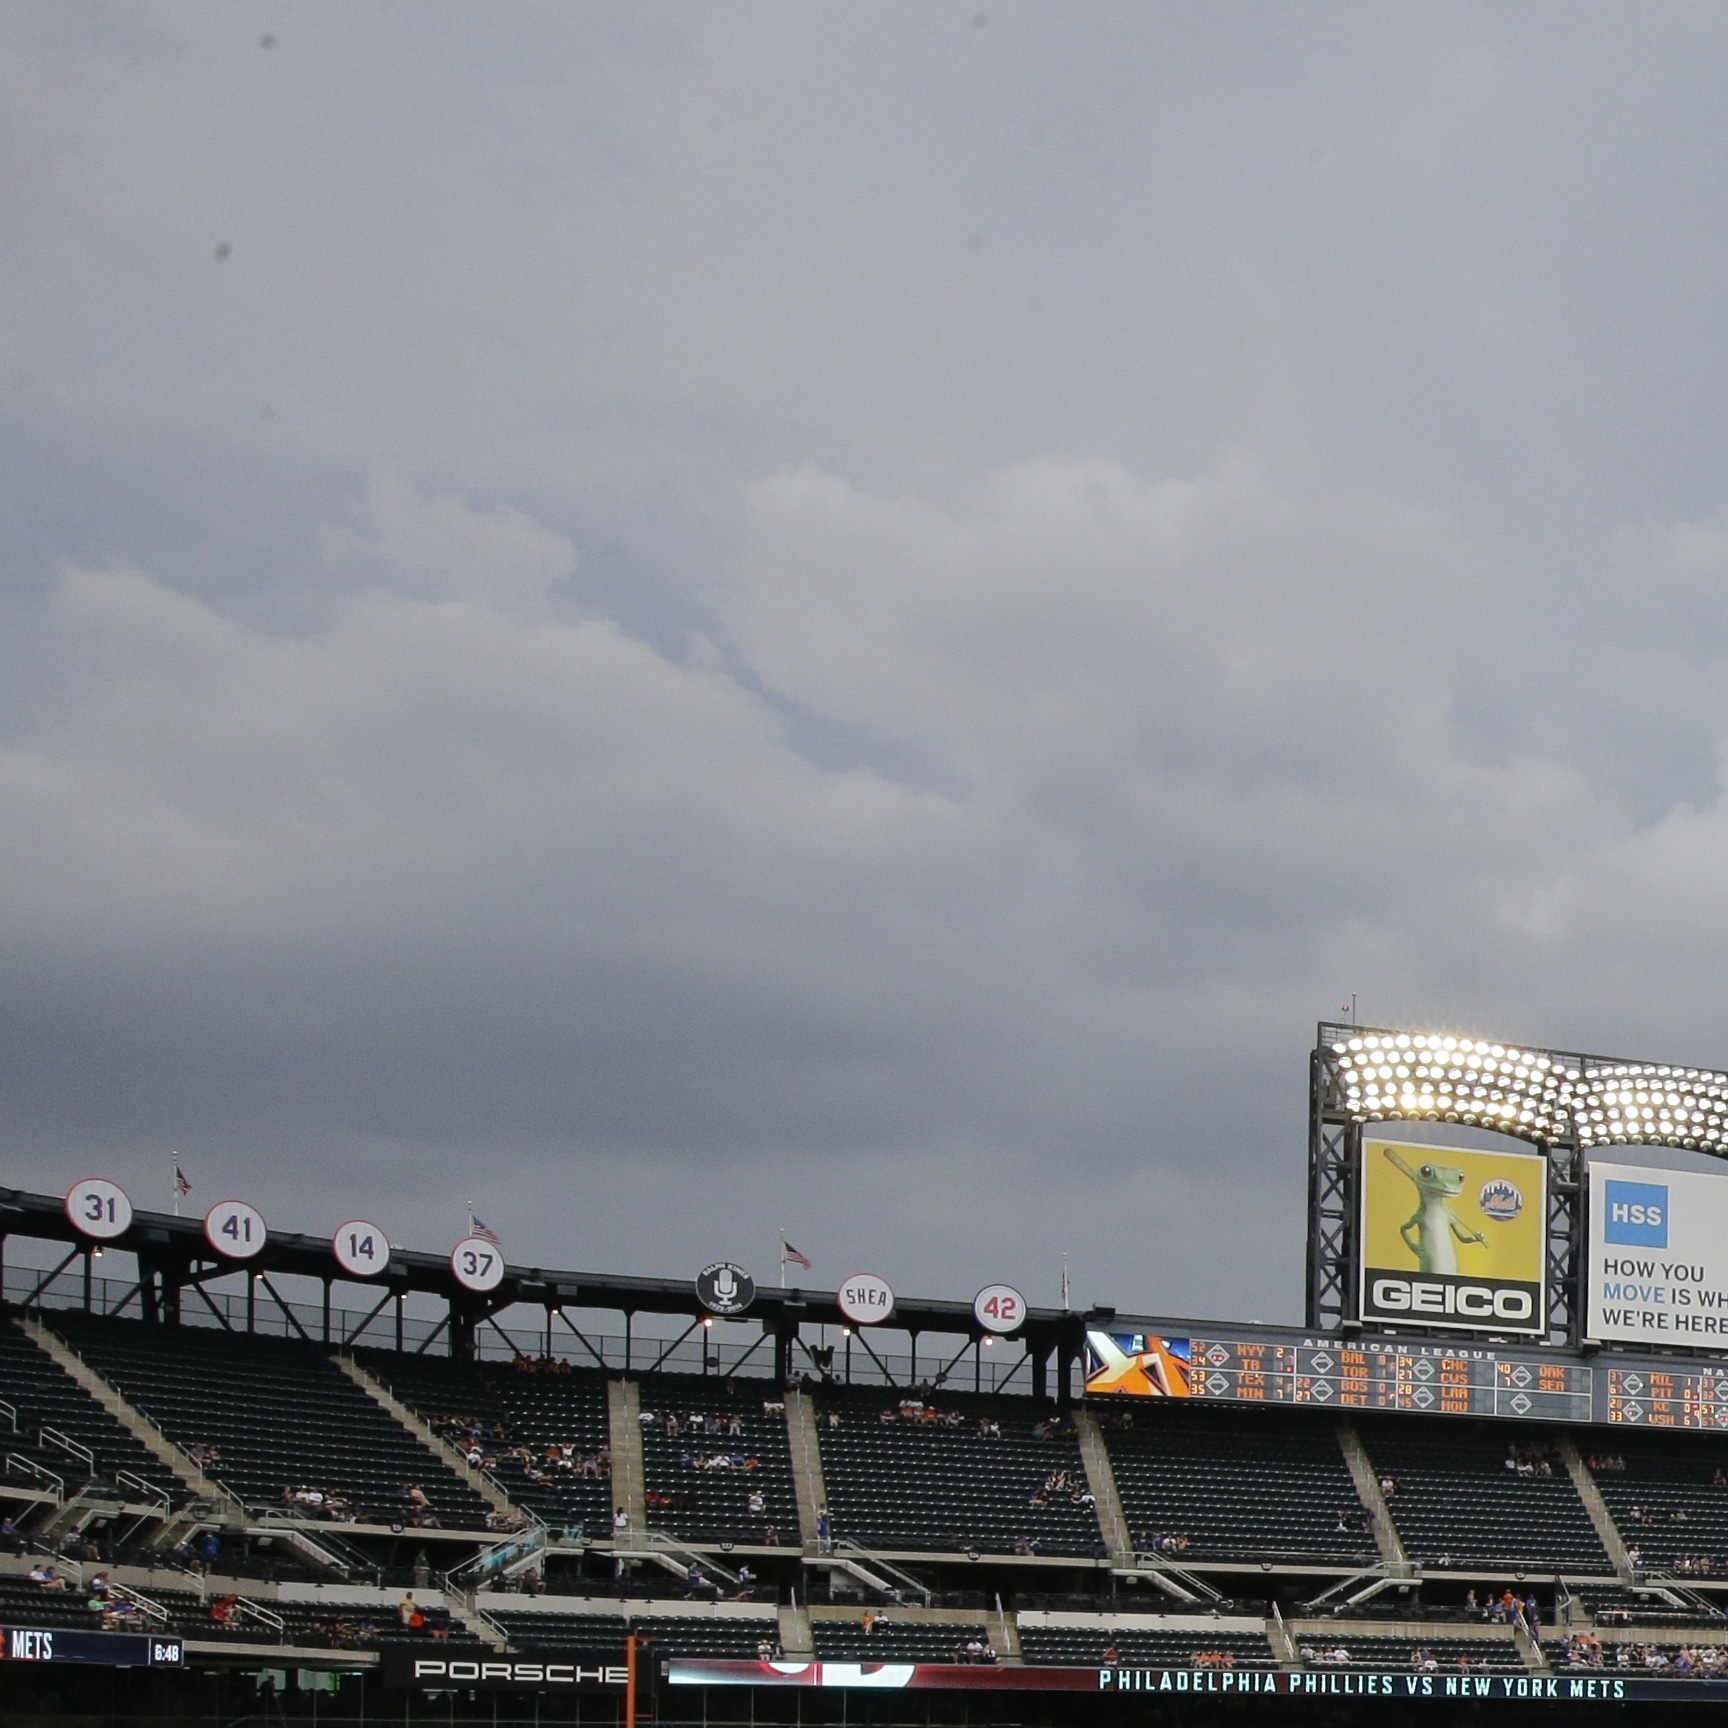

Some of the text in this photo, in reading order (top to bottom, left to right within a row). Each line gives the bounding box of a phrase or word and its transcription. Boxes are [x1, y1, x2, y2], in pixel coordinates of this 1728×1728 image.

[85, 1196, 116, 1222] 31
[1612, 1203, 1662, 1226] HSS
[222, 1215, 252, 1241] 41
[349, 1234, 374, 1260] 14
[463, 1252, 493, 1276] 37
[1604, 1259, 1705, 1282] HOW YOU
[846, 1289, 886, 1306] SHEA
[1372, 1279, 1532, 1319] GEICO
[1604, 1284, 1665, 1304] MOVE
[1671, 1287, 1691, 1304] IS
[984, 1297, 1015, 1319] 42
[1603, 1308, 1668, 1329] WE'RE
[1303, 1338, 1496, 1360] AMERICAN LEAGUE
[12, 1631, 52, 1660] METS
[155, 1643, 179, 1662] 6:48
[415, 1660, 631, 1683] PORSCHE
[1099, 1669, 1624, 1698] PHILADELPHIA PHILLIES VS NEW YORK METS
